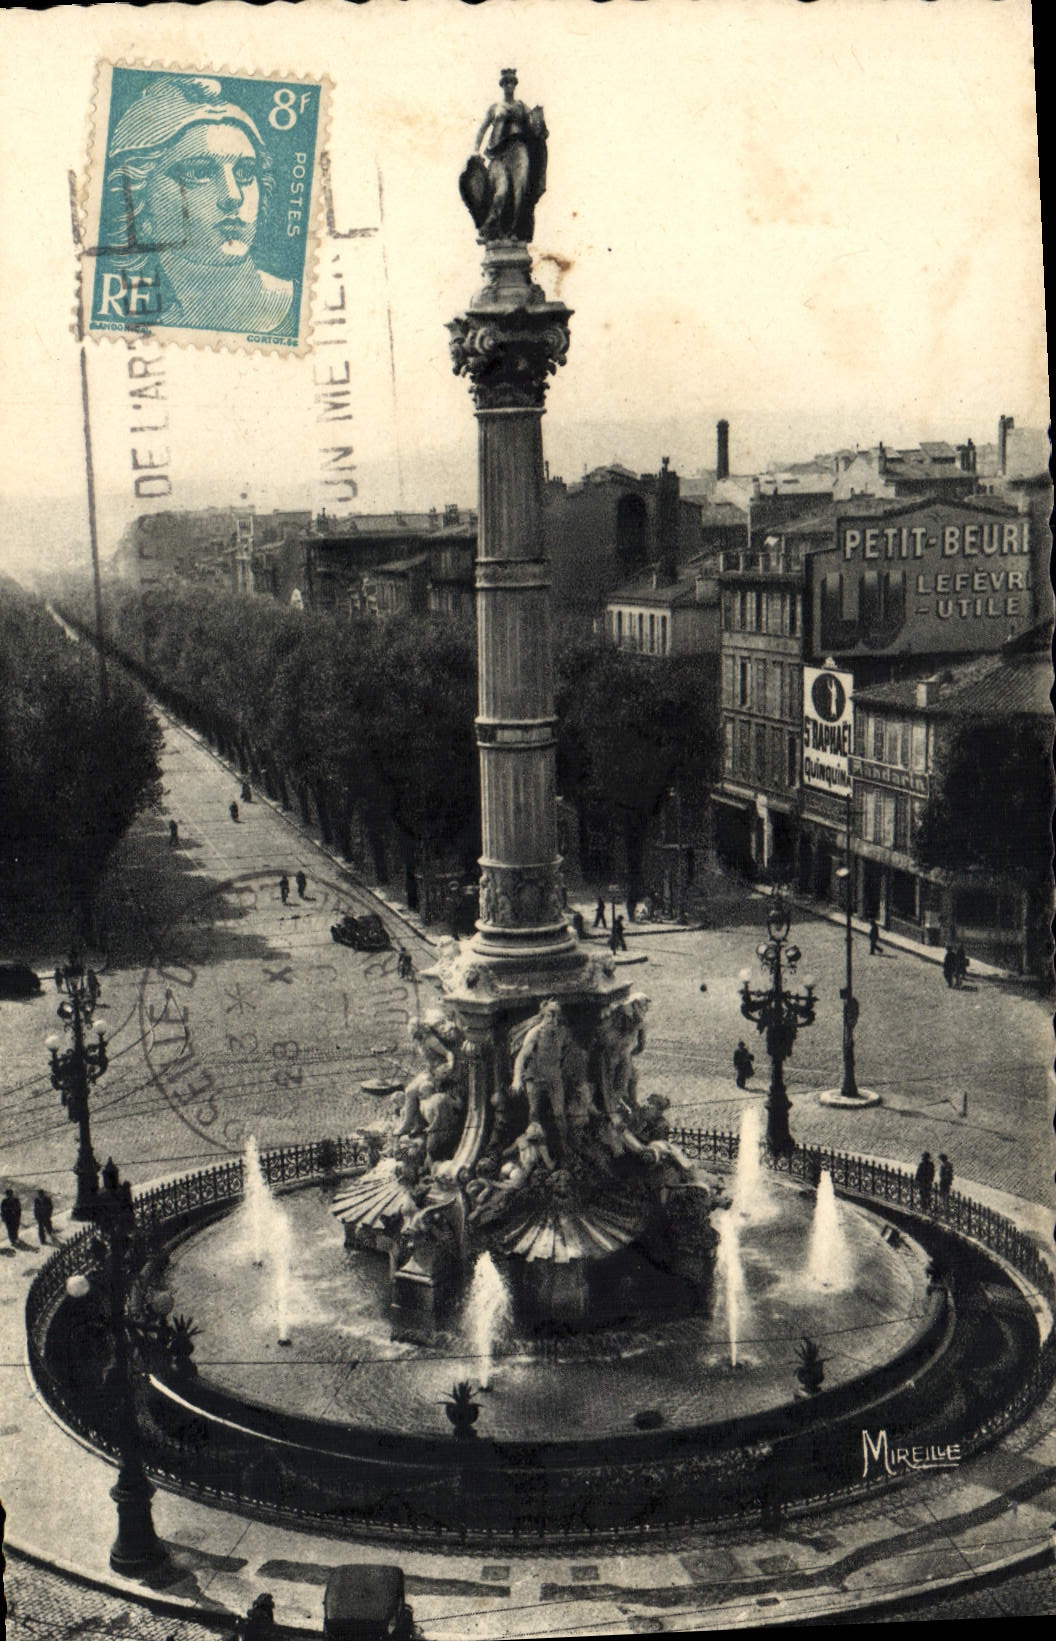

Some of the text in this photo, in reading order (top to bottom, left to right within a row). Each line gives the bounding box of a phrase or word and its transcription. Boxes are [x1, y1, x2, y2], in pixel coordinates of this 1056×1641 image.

[286, 152, 307, 237] POSTES
[97, 272, 153, 318] RF
[917, 567, 1030, 594] LEFÈVR
